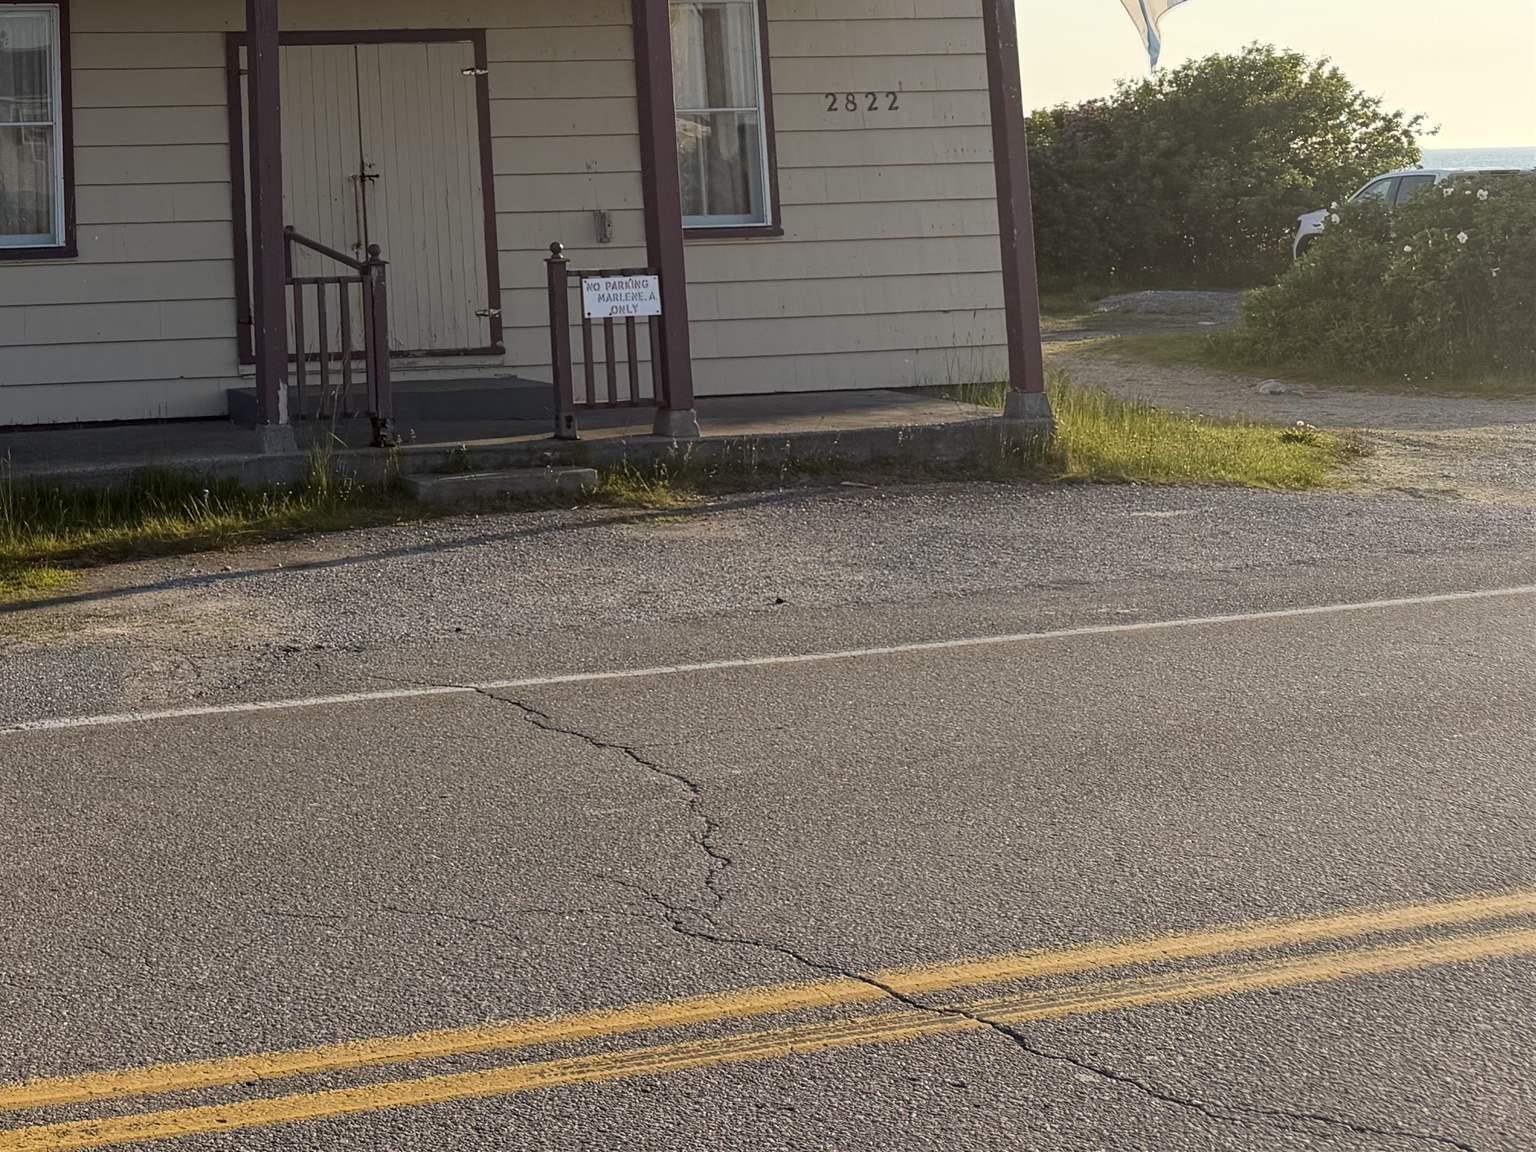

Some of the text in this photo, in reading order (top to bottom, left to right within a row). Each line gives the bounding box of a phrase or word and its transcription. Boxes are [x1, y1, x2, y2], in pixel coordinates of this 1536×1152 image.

[824, 92, 899, 111] 2822
[586, 279, 649, 292] NO PARKING
[611, 304, 639, 314] ONLY
